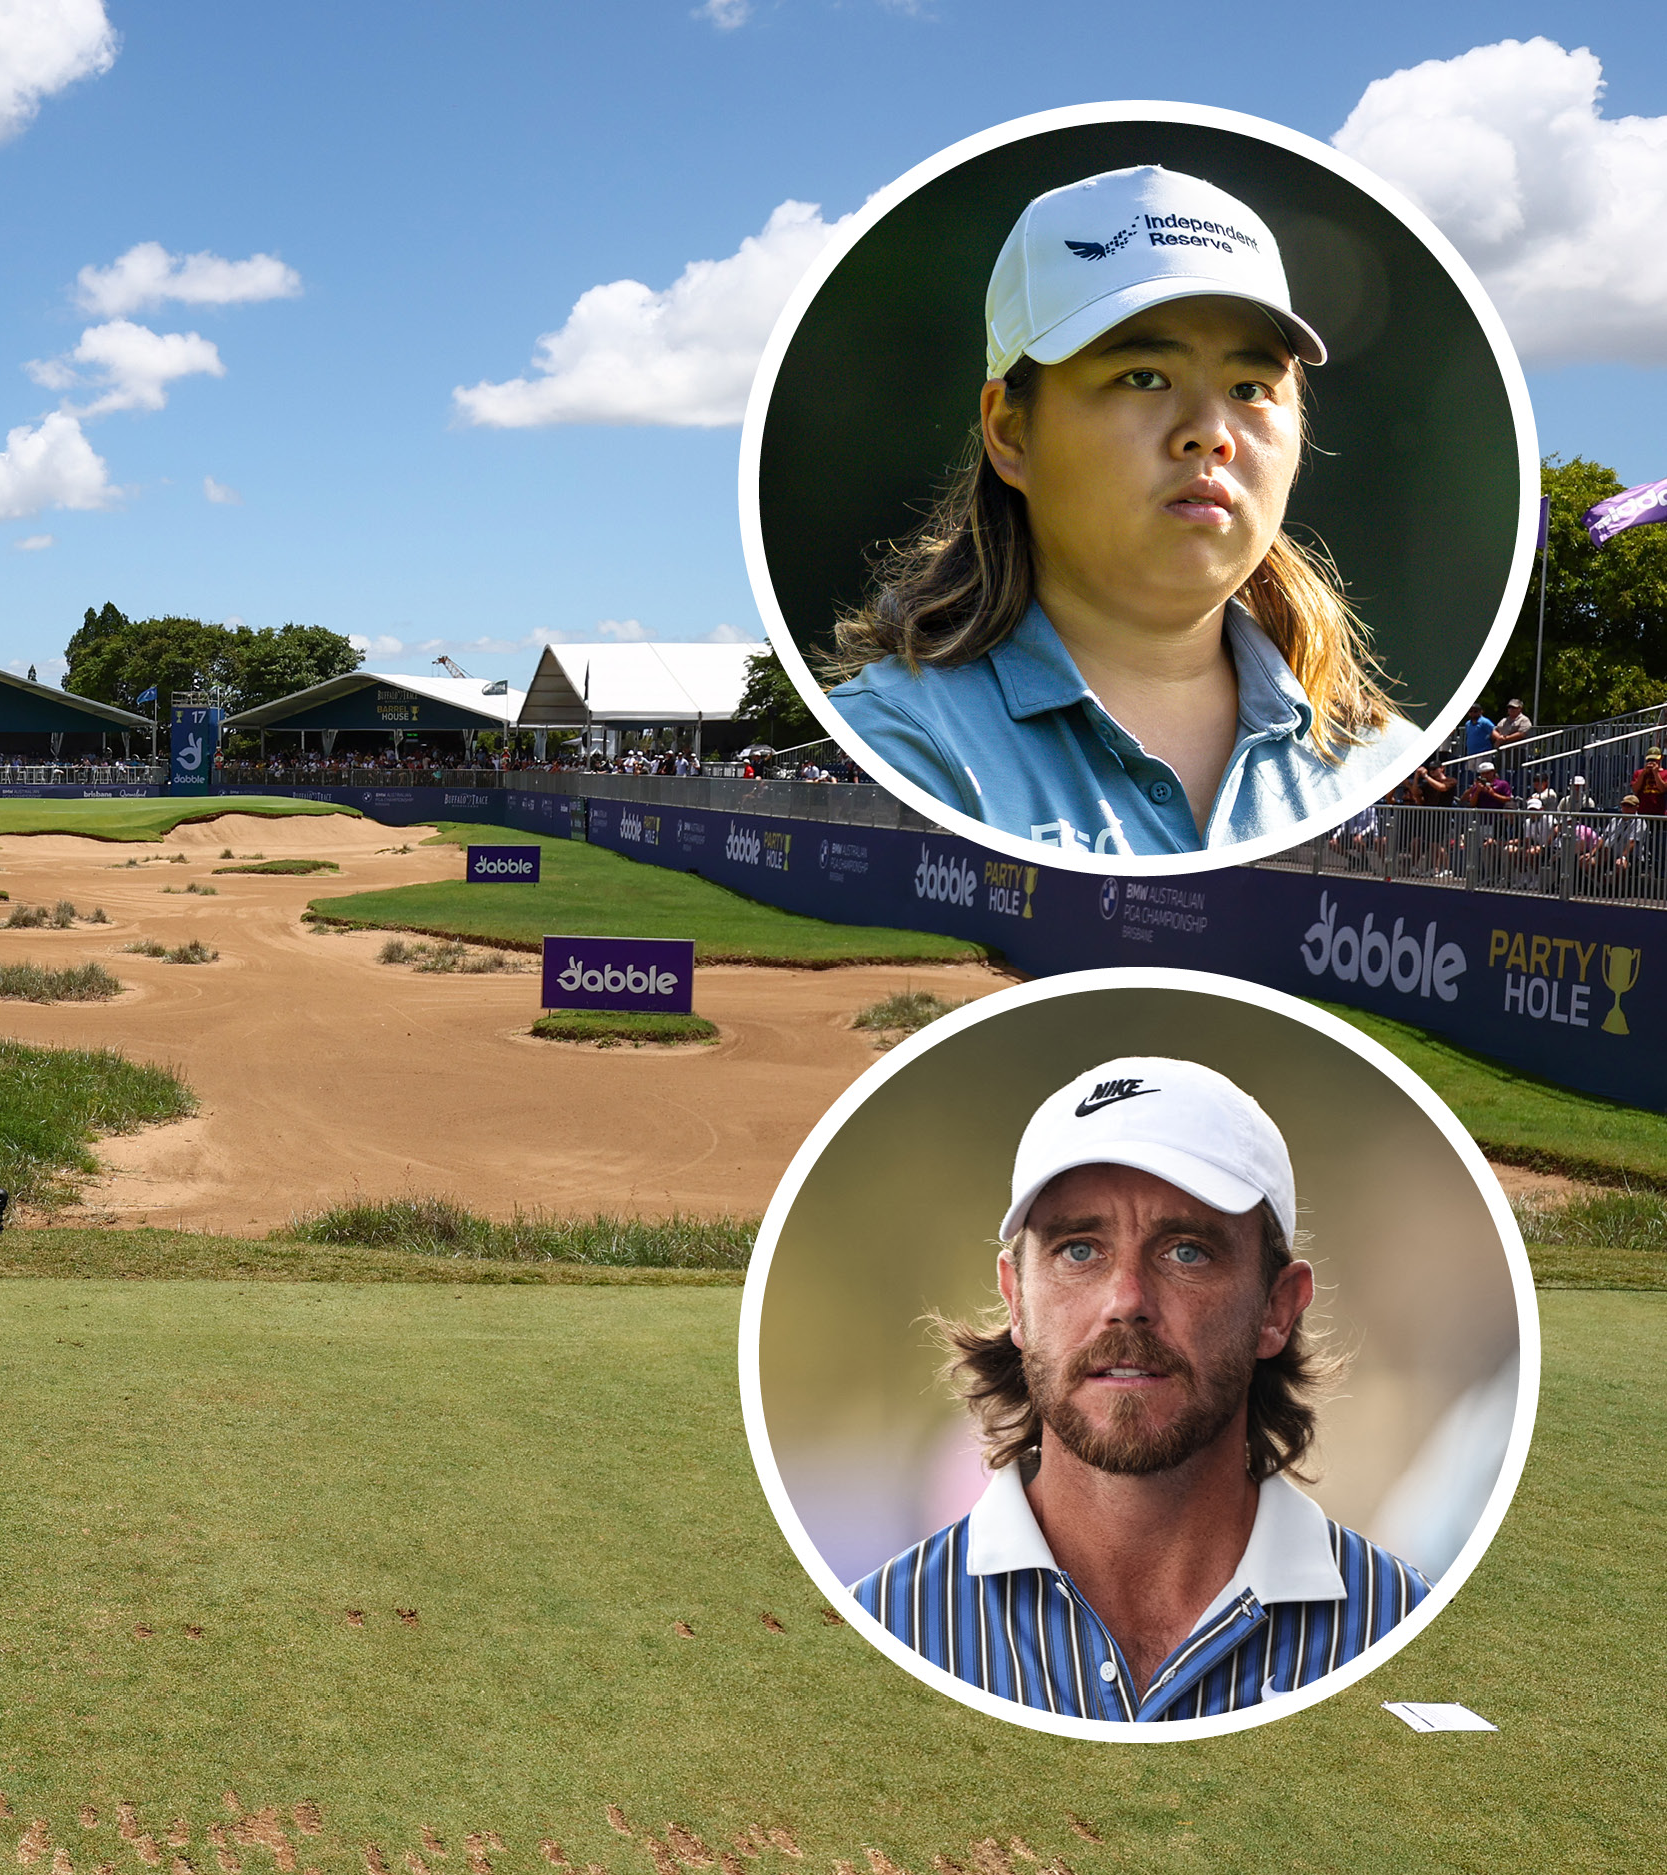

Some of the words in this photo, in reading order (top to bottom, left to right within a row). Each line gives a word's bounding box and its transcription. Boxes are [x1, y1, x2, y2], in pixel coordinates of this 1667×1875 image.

[1144, 213, 1261, 254] Independent
[1149, 232, 1234, 254] Reserve
[191, 710, 207, 724] 17
[381, 712, 410, 720] HOUSE
[173, 773, 206, 784] dabble
[726, 819, 761, 865] dabble
[764, 831, 784, 849] PARTY
[474, 854, 534, 875] dabble
[766, 851, 783, 869] HOLE
[914, 841, 978, 908] dabble
[984, 860, 1024, 890] PARTY
[988, 888, 1020, 916] HOLE
[1126, 882, 1149, 901] BMW
[1149, 887, 1206, 910] AUSTRALIAN
[1124, 903, 1141, 922] PGA
[1141, 908, 1209, 934] CHAMPIONSHIP
[1300, 890, 1468, 1002] dabble
[1488, 929, 1598, 982] PARTY
[556, 955, 679, 995] dabble
[1505, 972, 1591, 1027] HOLE
[1088, 1079, 1144, 1102] NIKE
